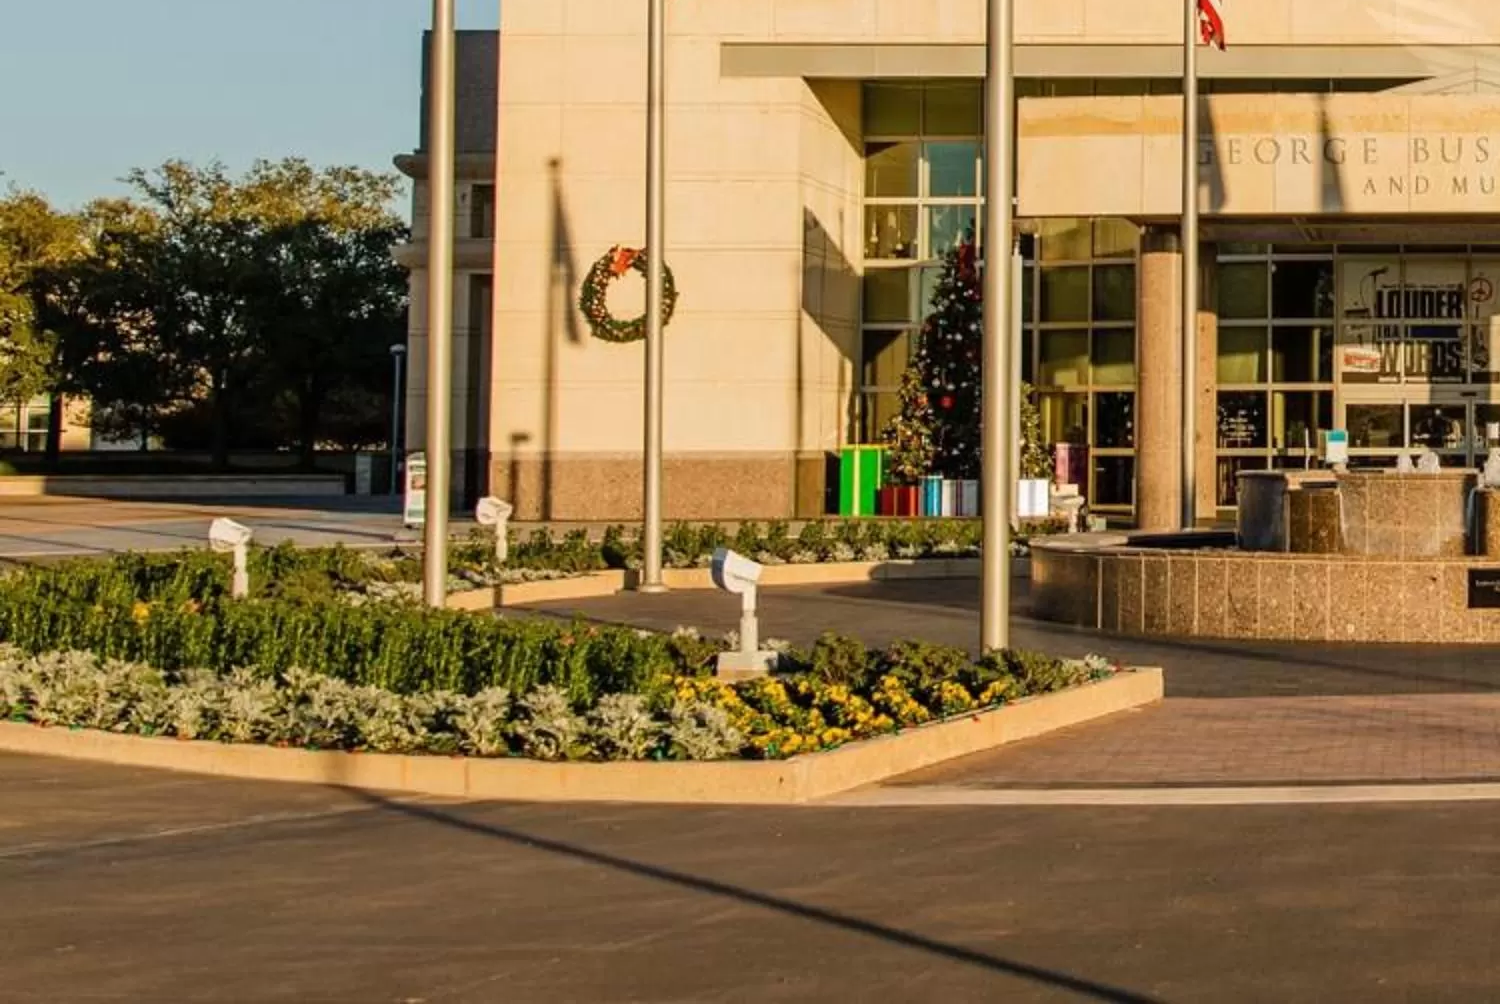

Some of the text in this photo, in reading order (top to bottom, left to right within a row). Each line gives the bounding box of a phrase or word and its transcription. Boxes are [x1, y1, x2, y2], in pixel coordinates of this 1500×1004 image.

[1197, 138, 1378, 165] GEORGE
[1363, 175, 1430, 195] AND
[1377, 340, 1461, 374] WORDS
